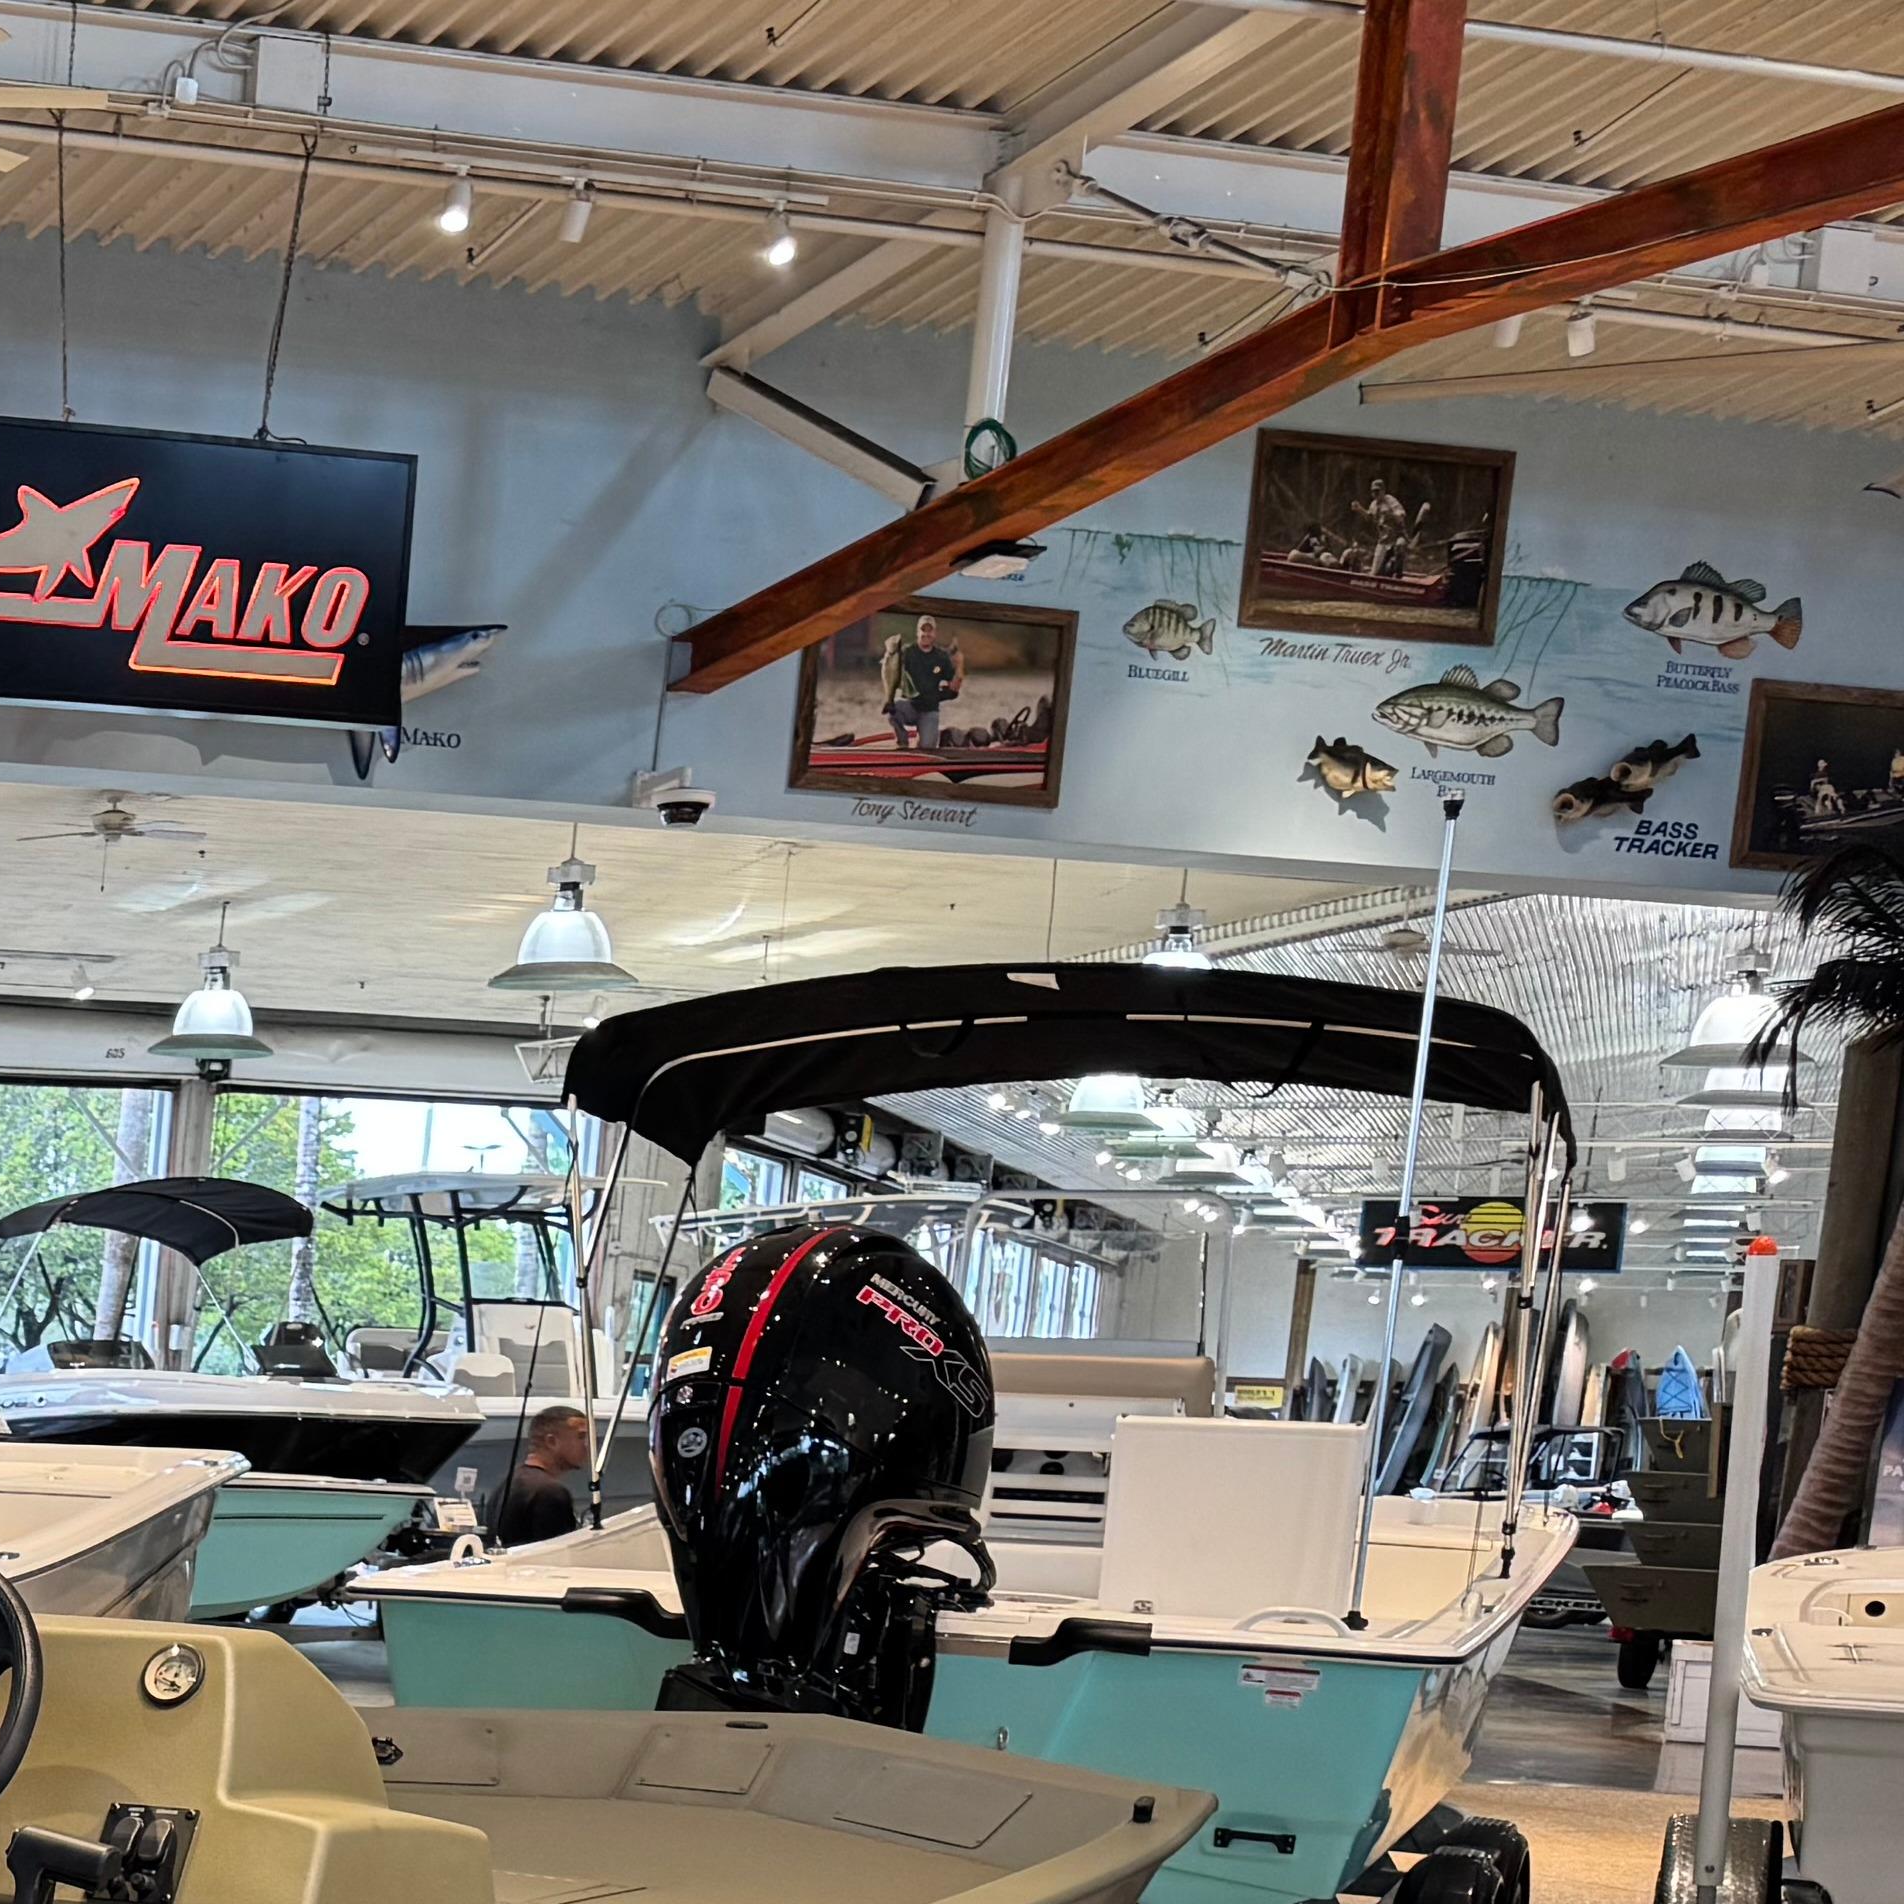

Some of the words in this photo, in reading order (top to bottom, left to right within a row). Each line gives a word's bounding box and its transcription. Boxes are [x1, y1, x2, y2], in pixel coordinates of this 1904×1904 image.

[76, 538, 370, 684] MAKO
[1259, 637, 1329, 661] Martin
[1411, 766, 1496, 786] LARGEMOUTH
[850, 797, 895, 824] Tony
[898, 800, 978, 828] Stewart
[1633, 818, 1700, 840] BASS
[1613, 836, 1720, 860] TRACKER
[869, 1272, 942, 1326] MERCURY
[856, 1284, 945, 1357] PRO
